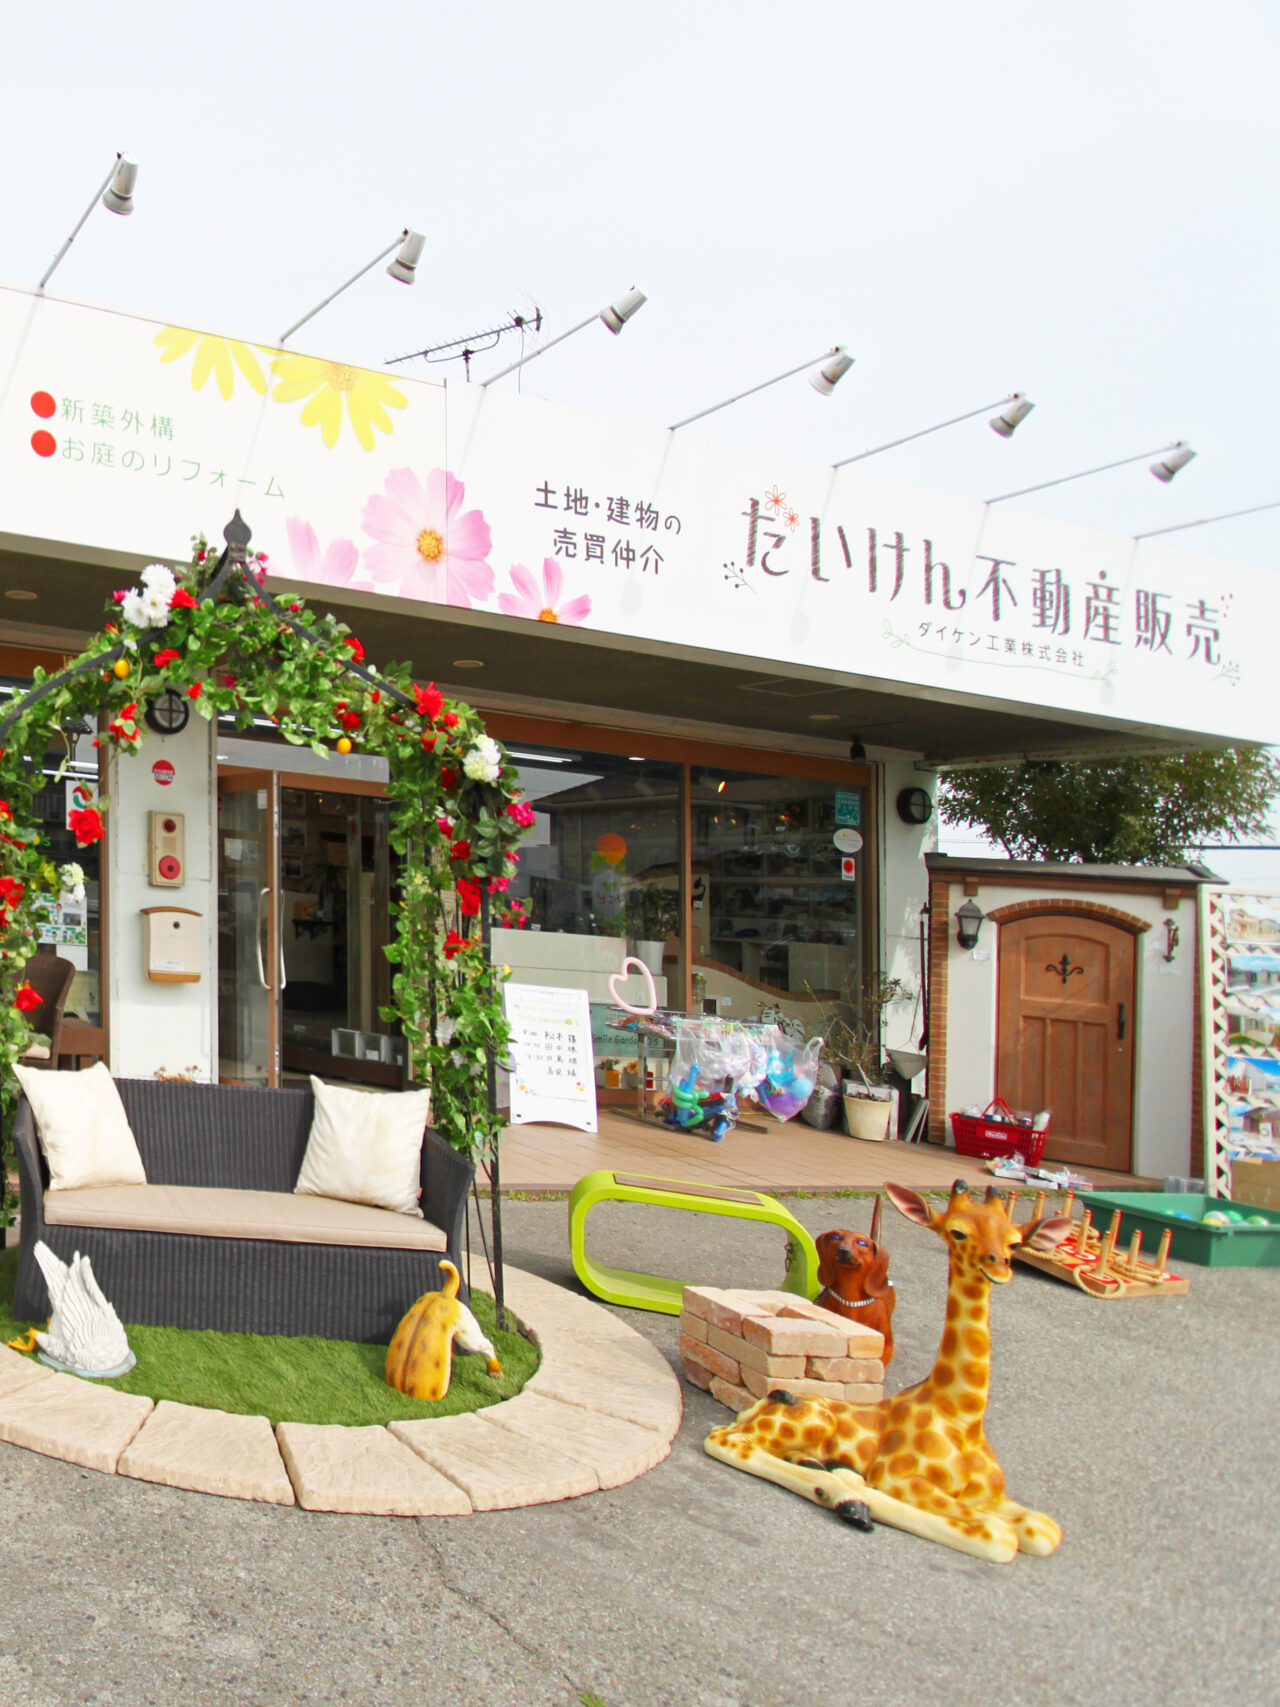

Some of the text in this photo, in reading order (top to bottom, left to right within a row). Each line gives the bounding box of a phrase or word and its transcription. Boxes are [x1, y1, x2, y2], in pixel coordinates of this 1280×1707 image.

[61, 397, 174, 441] 新築外構
[61, 436, 286, 499] お庭のリフォーム
[534, 480, 682, 535] 土地・建物の
[553, 527, 665, 575] 売買仲介
[919, 621, 1085, 667] ダイケン工業株式会社
